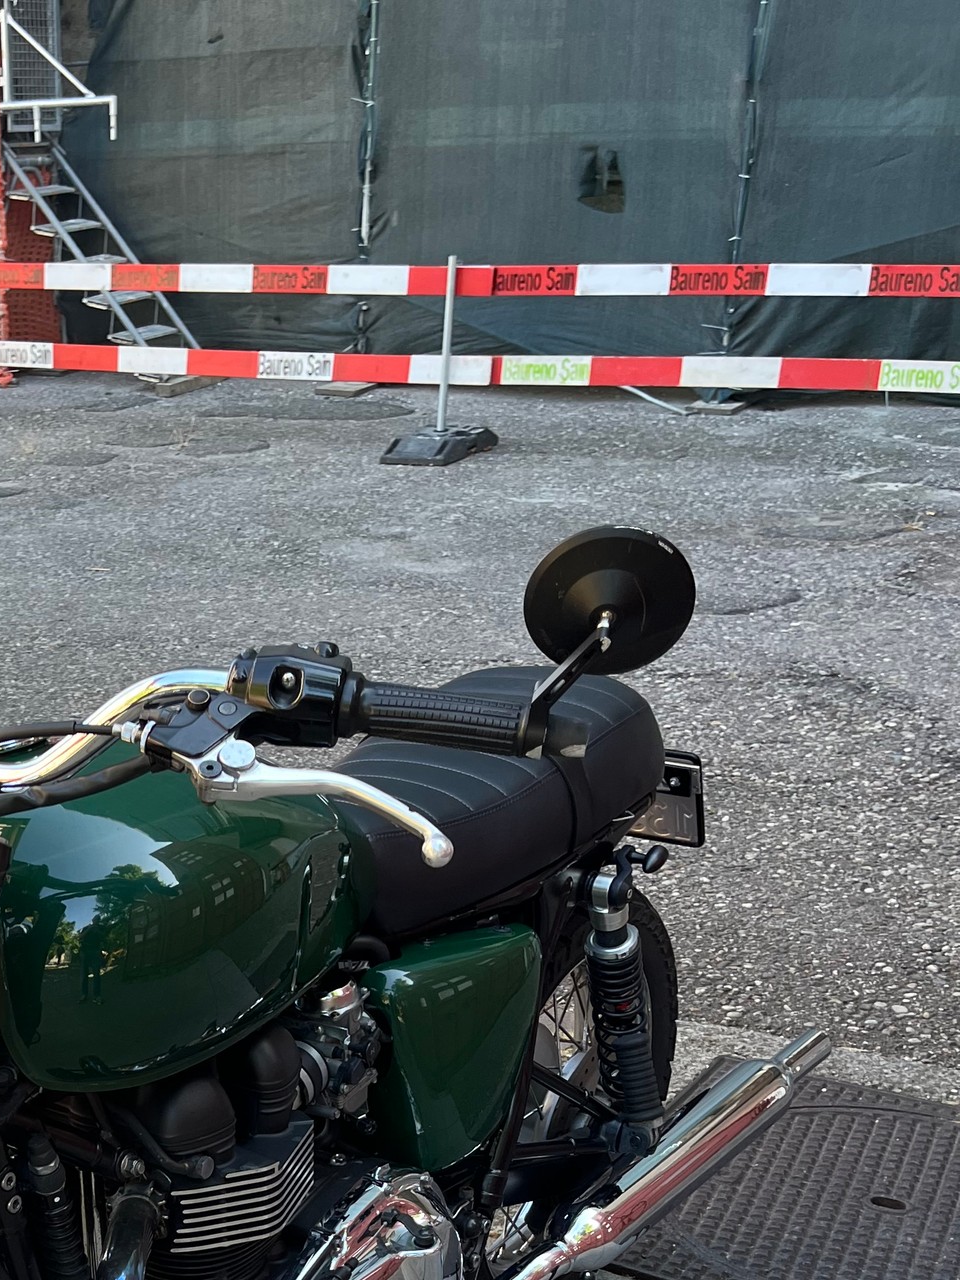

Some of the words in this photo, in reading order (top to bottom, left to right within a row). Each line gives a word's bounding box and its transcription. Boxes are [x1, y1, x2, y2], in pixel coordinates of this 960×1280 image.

[669, 265, 728, 292] Baureno
[868, 266, 933, 293] Baureno
[880, 362, 945, 389] Baureno
